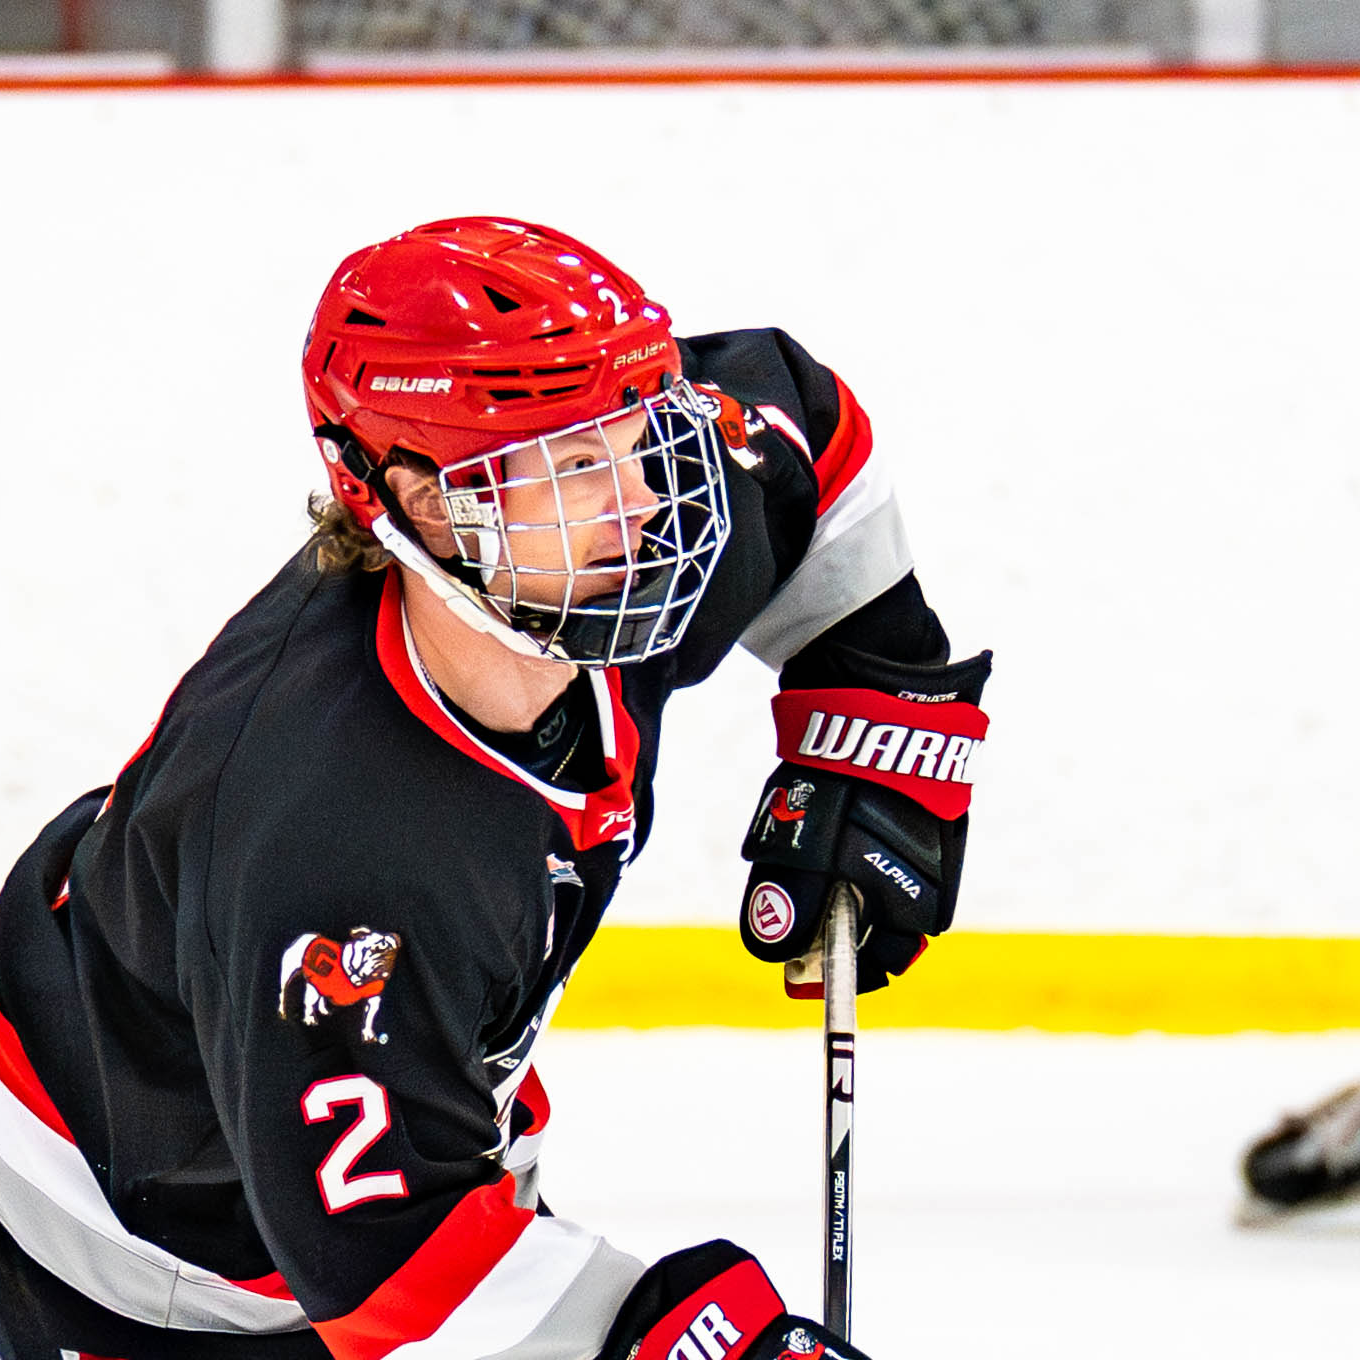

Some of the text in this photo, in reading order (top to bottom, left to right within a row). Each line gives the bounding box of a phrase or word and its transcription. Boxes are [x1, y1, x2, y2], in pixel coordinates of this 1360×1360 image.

[597, 287, 630, 325] 2
[369, 376, 453, 393] BAUER
[862, 852, 921, 900] ALPHA
[299, 1073, 409, 1214] 2
